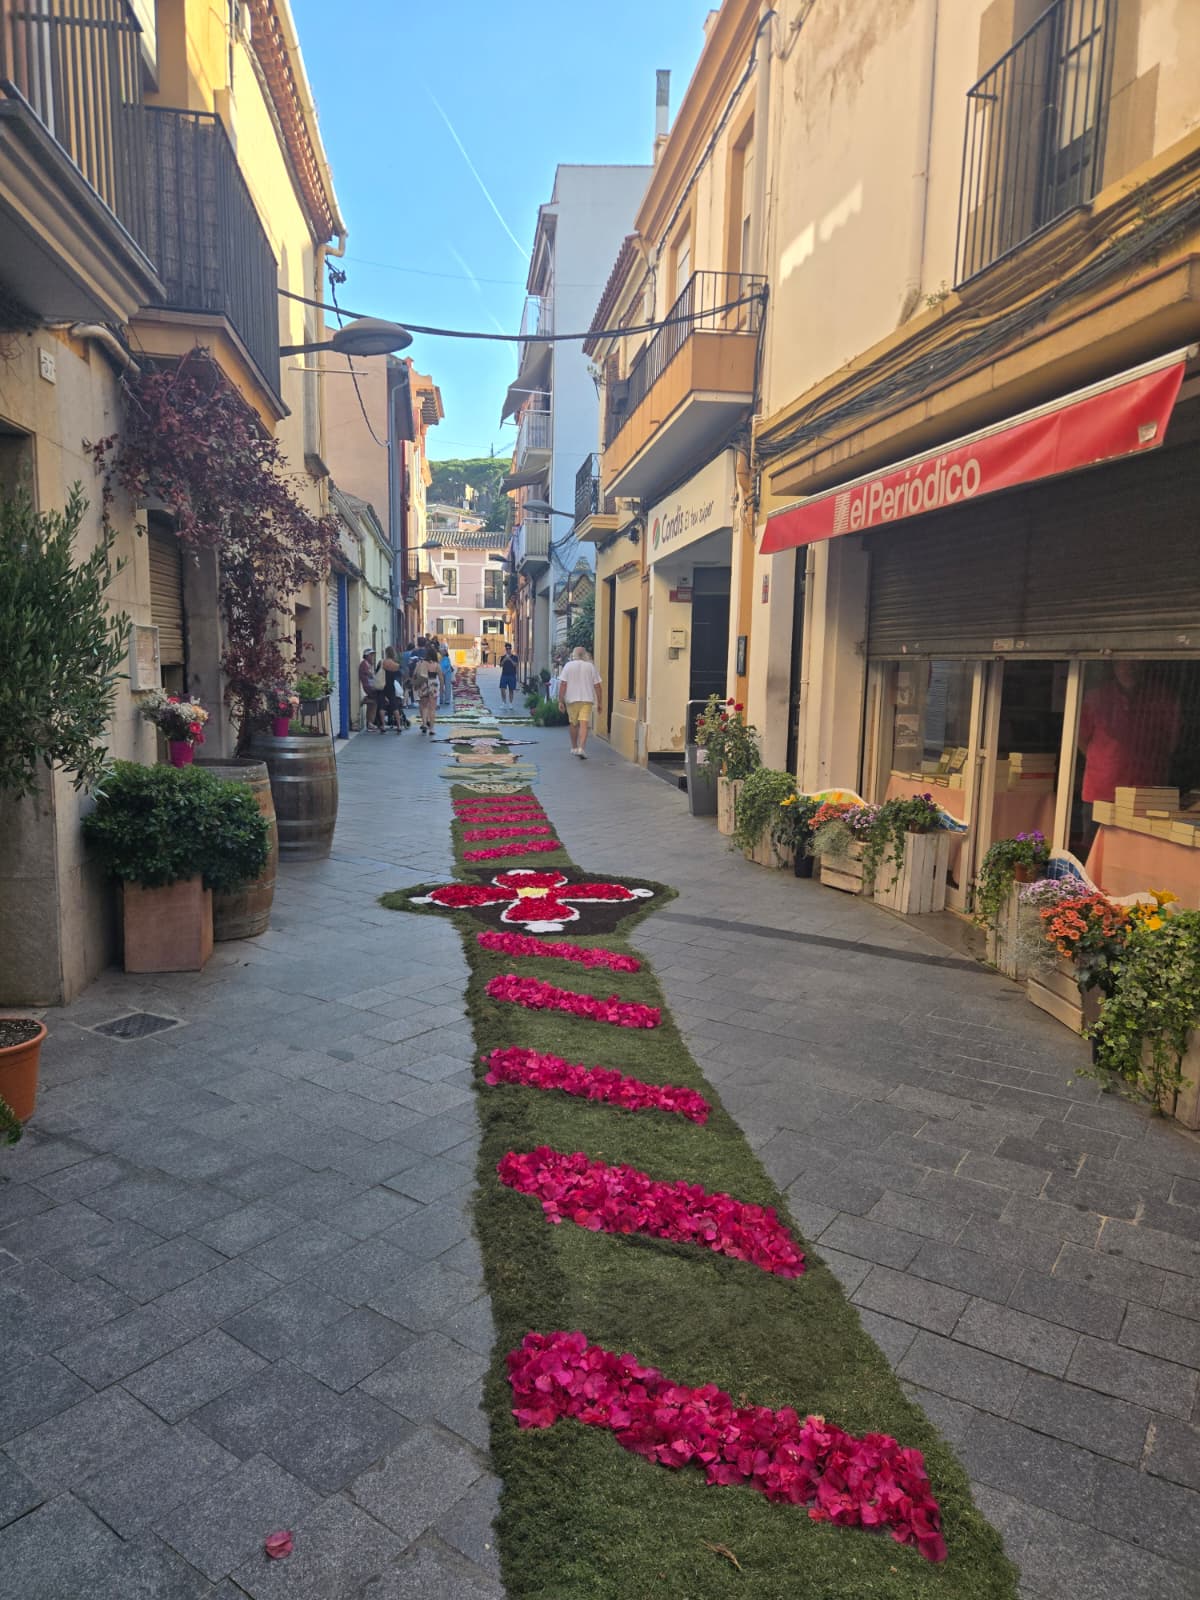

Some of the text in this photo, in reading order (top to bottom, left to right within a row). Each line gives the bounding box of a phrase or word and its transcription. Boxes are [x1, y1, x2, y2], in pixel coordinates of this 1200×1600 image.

[850, 456, 981, 529] el Periódico
[662, 505, 684, 544] Condis
